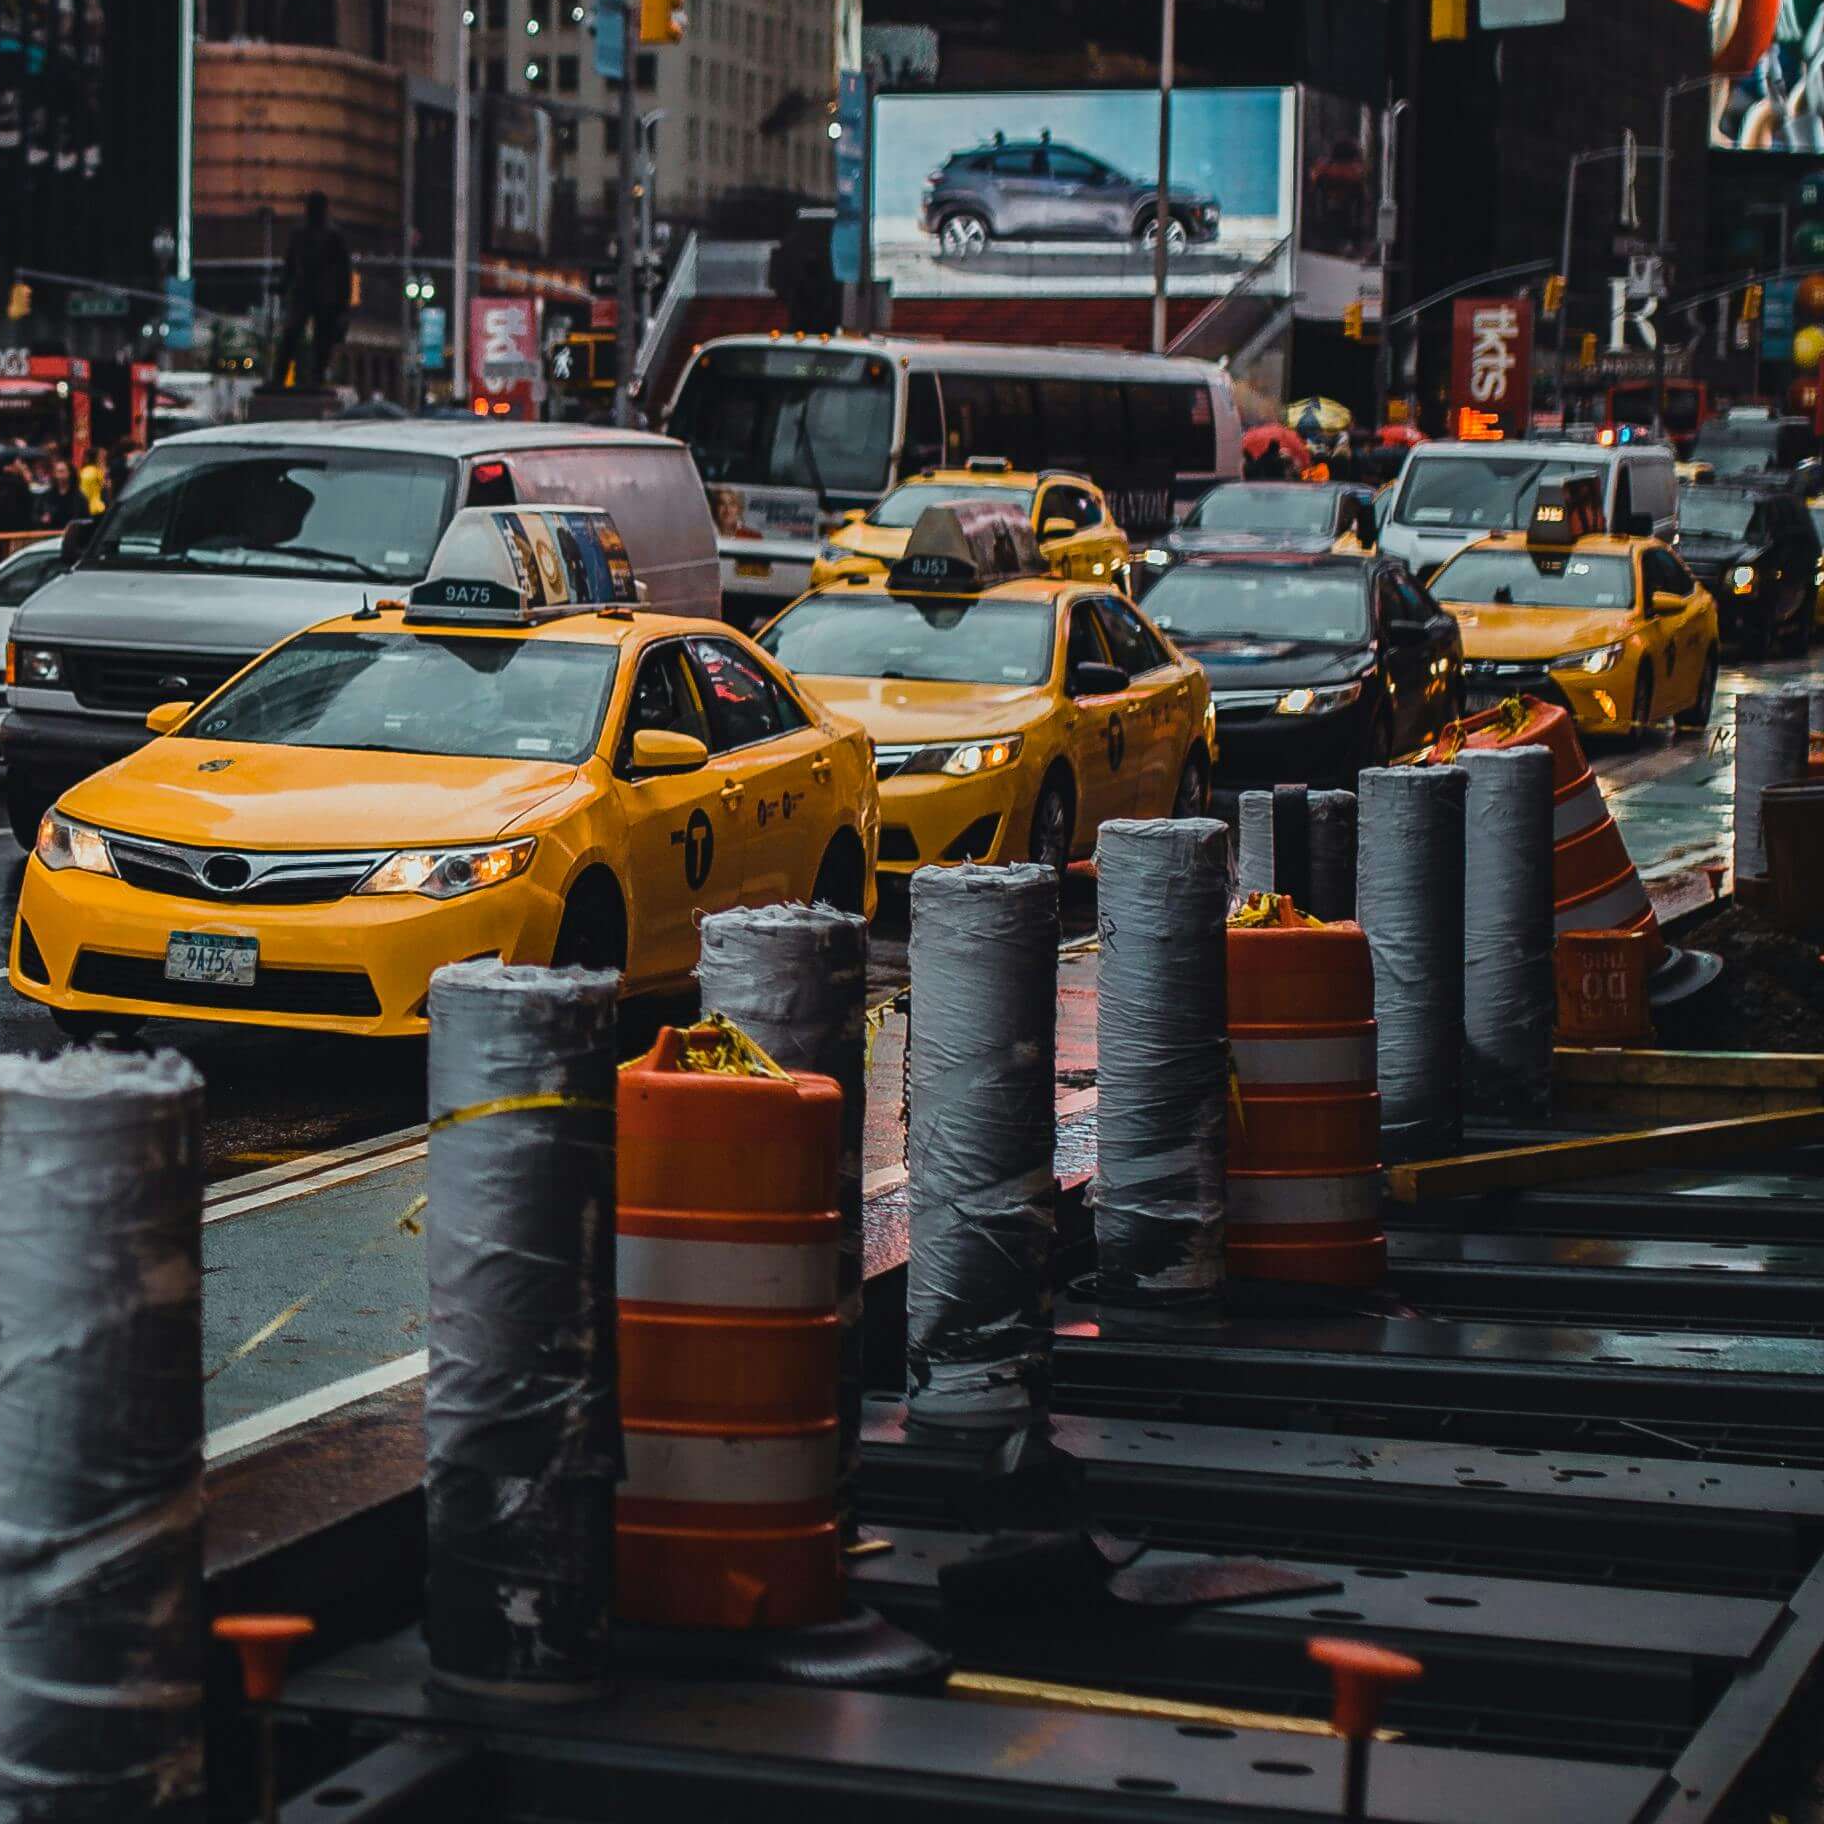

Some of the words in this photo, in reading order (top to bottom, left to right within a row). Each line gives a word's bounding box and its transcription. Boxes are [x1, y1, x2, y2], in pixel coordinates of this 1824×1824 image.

[1470, 303, 1519, 404] tkts
[444, 584, 492, 604] 9A75
[691, 825, 707, 880] T
